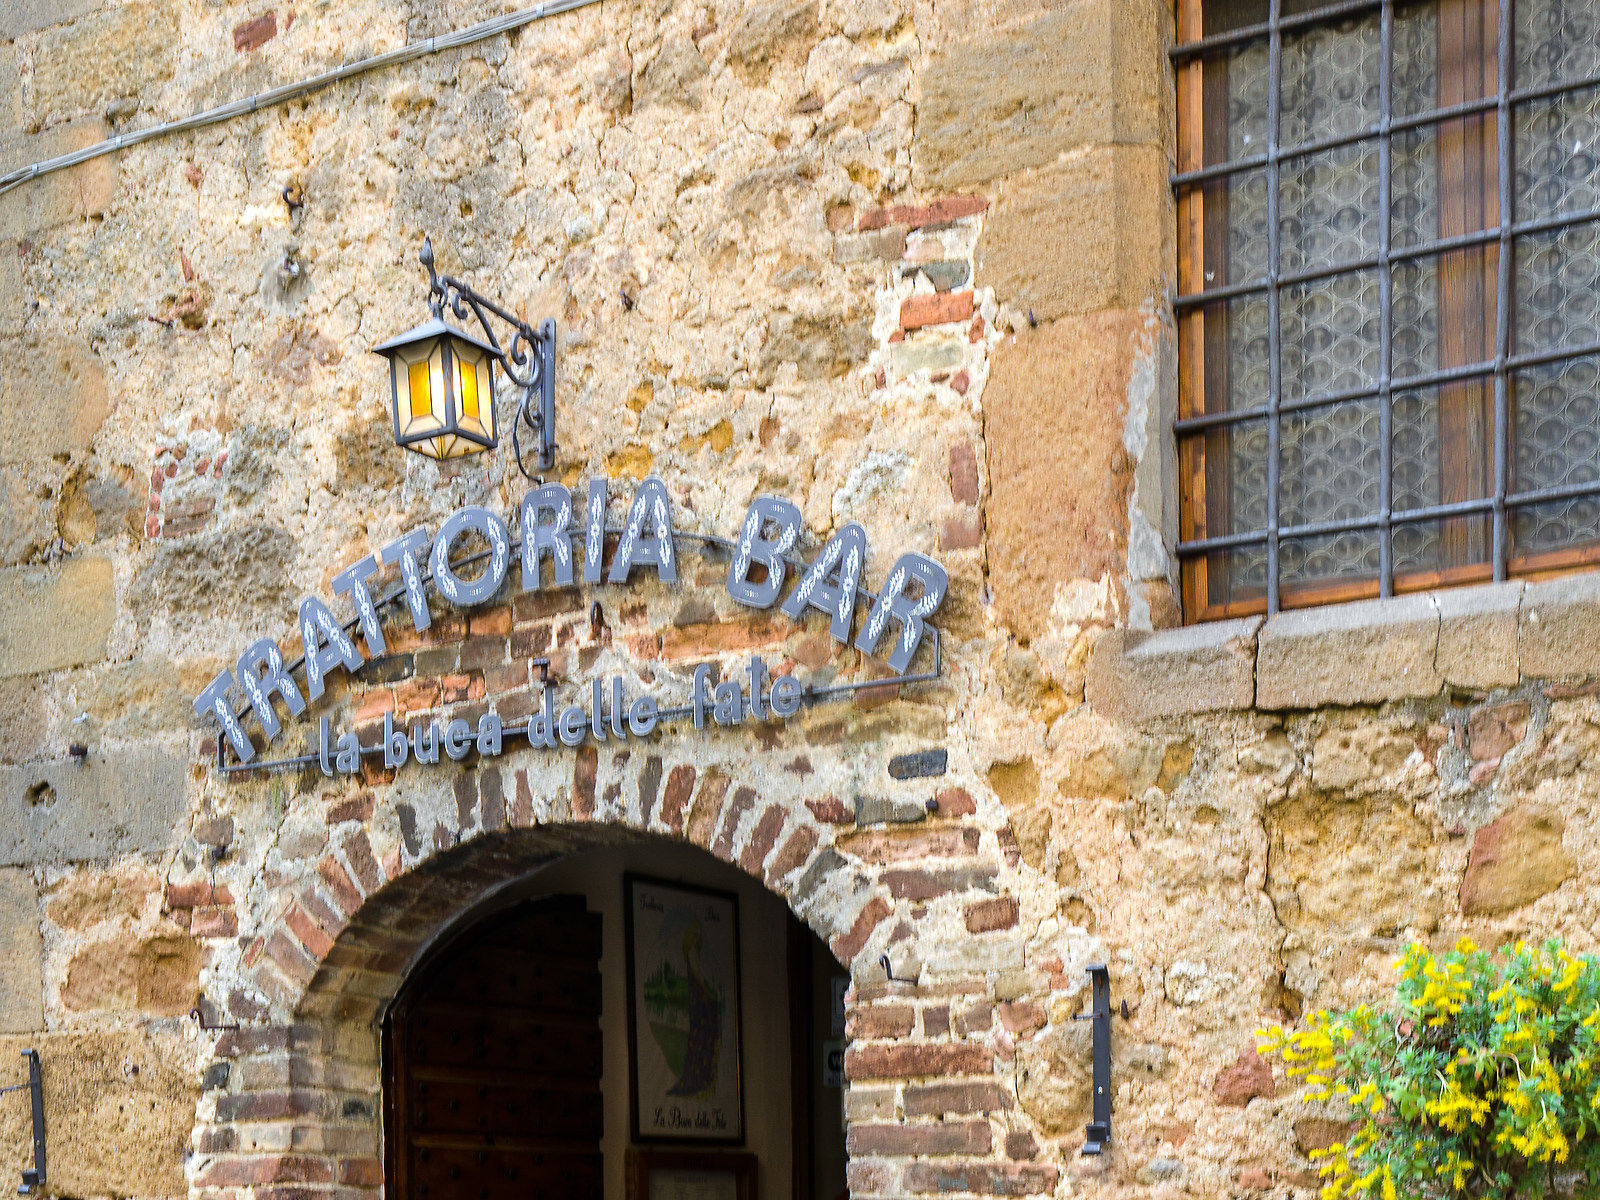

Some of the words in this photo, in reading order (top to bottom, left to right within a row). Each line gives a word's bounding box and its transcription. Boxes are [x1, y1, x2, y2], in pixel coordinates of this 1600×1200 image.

[194, 478, 677, 763] TRATTORIA
[729, 496, 949, 673] BAR
[320, 718, 361, 776] la
[384, 713, 503, 770] buca
[528, 677, 657, 747] delle
[693, 656, 801, 729] fate
